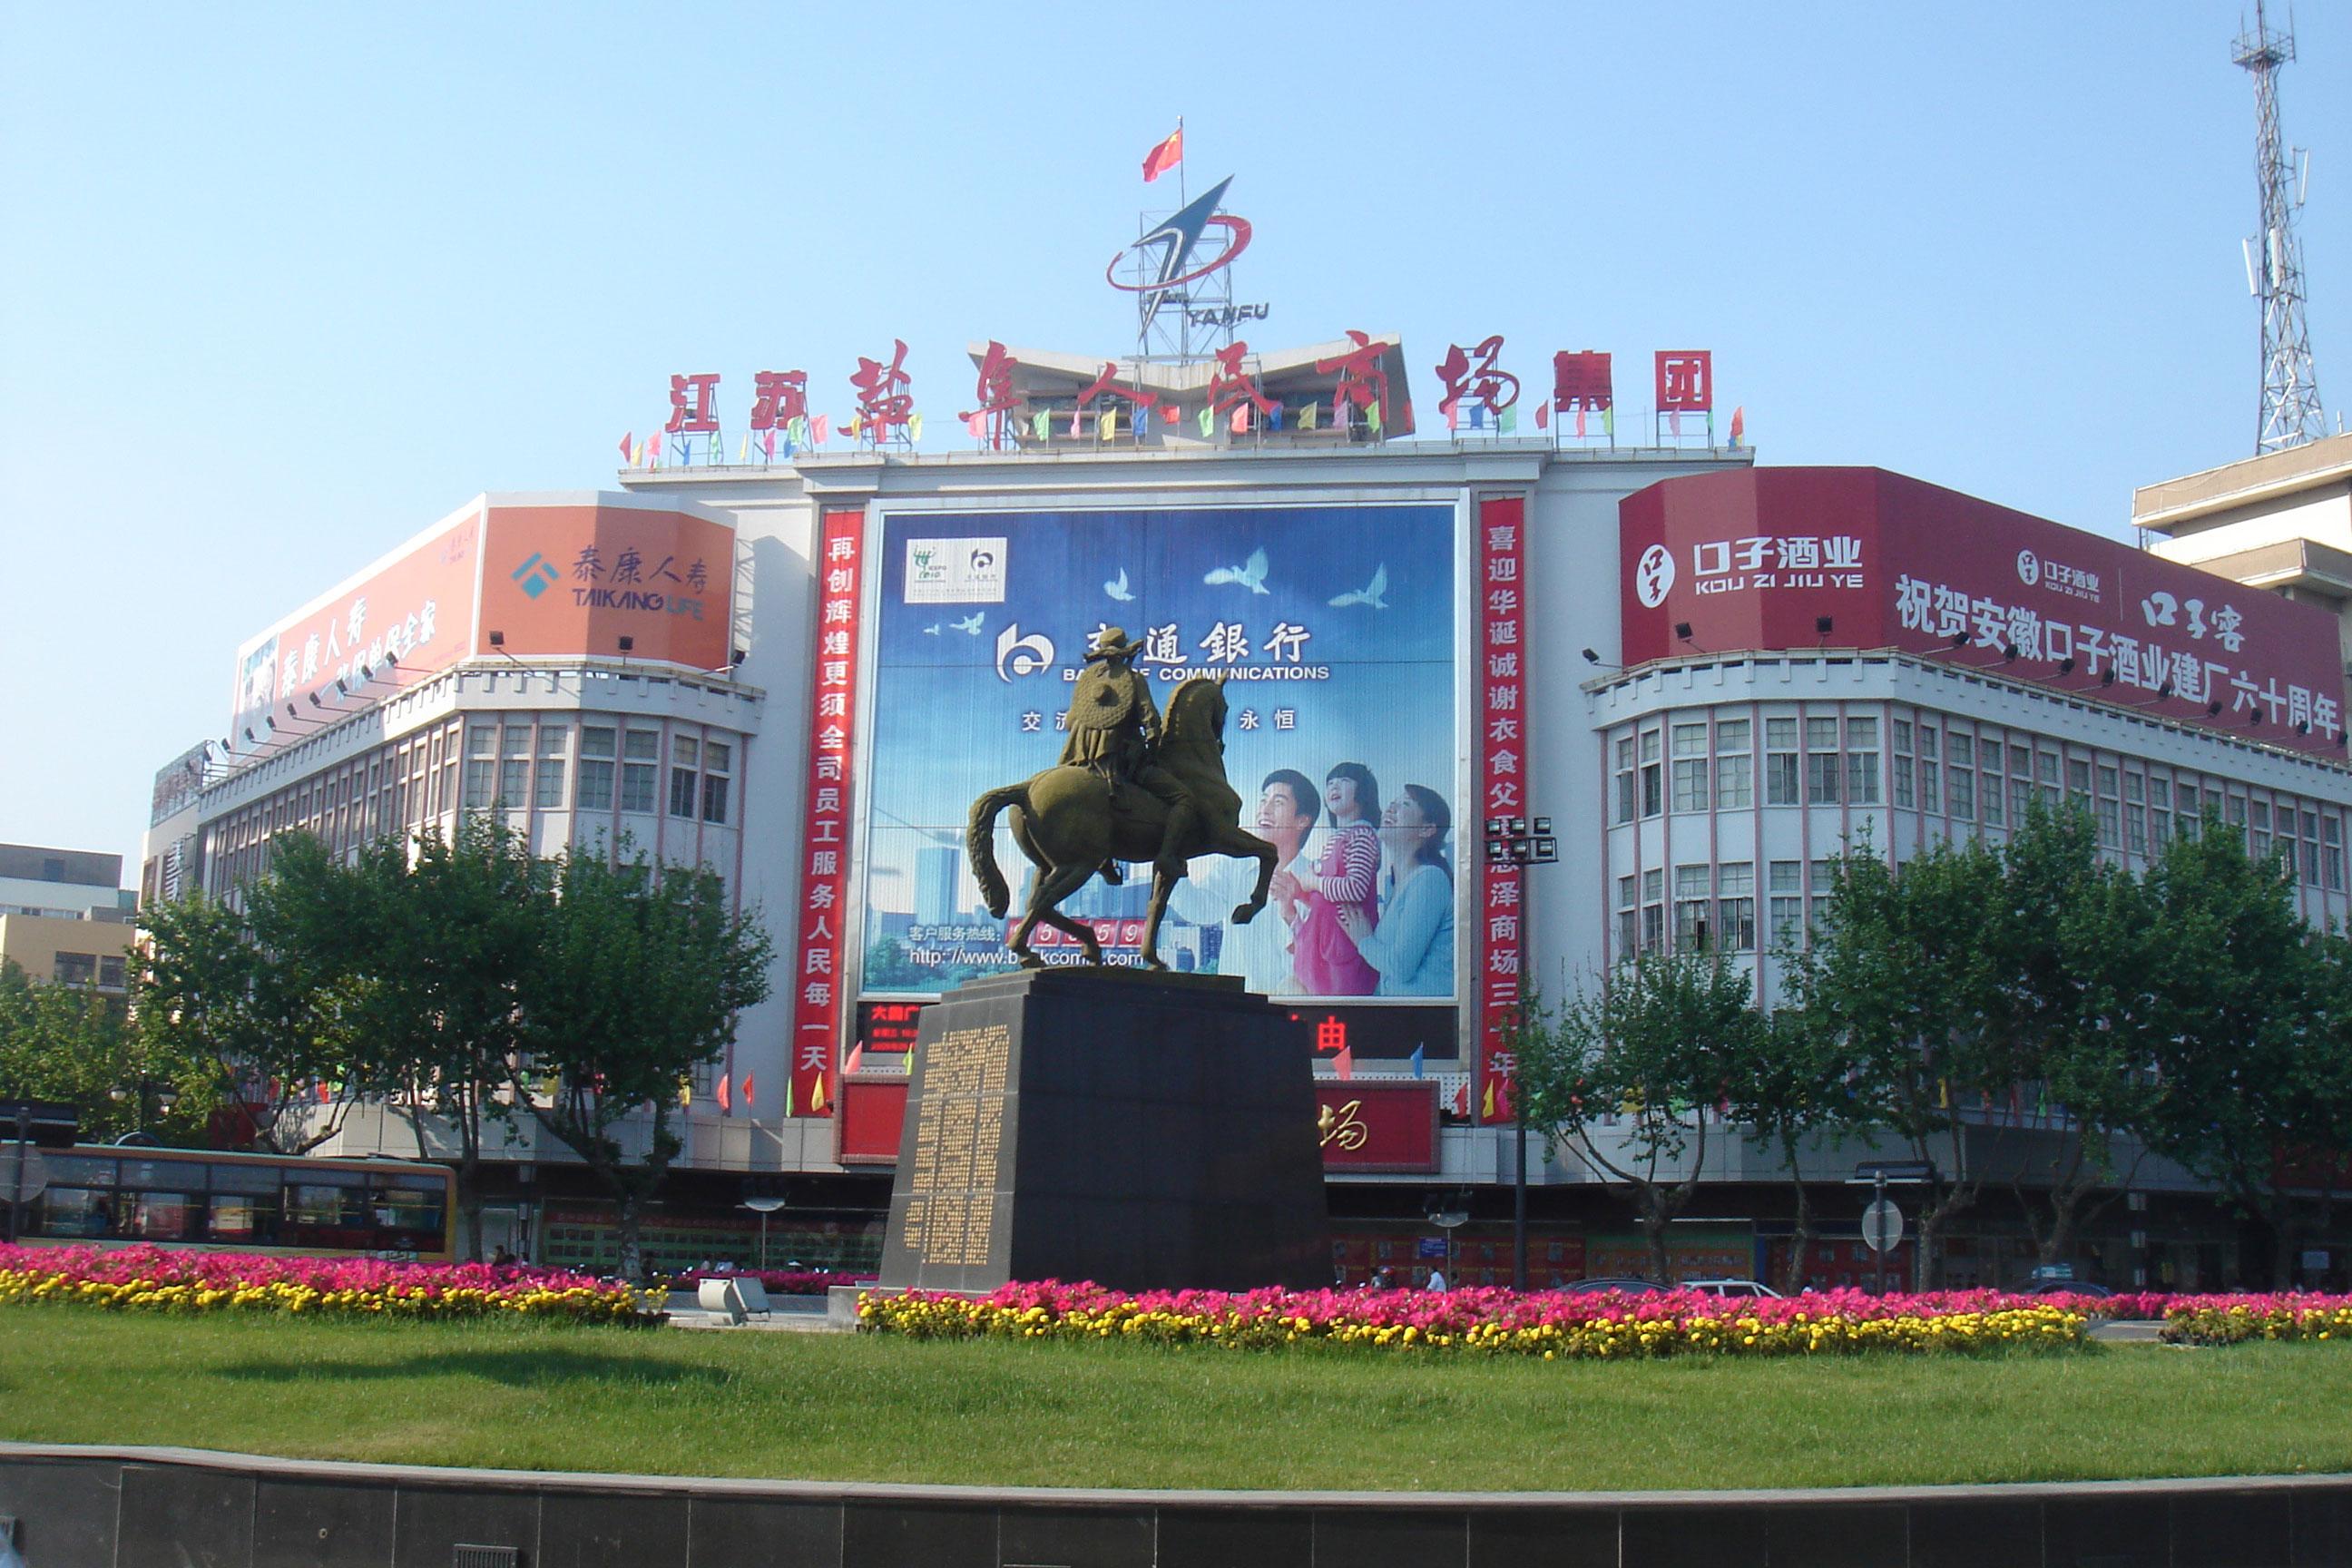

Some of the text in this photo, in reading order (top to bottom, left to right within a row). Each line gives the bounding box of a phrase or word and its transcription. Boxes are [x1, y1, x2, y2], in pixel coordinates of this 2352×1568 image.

[573, 544, 708, 594] 泰康人寿
[1693, 536, 1863, 576] 口子酒业
[2044, 560, 2100, 593] 口子酒业
[573, 588, 664, 611] TAIKANG
[1695, 573, 1864, 595] KOU ZI JIU YE
[1895, 573, 2341, 740] 祝贺安徽口子酒业建厂六十周年
[800, 536, 856, 1072] 再创辉煌更须全司员工服务人民每一天
[1317, 1099, 1368, 1152] 场
